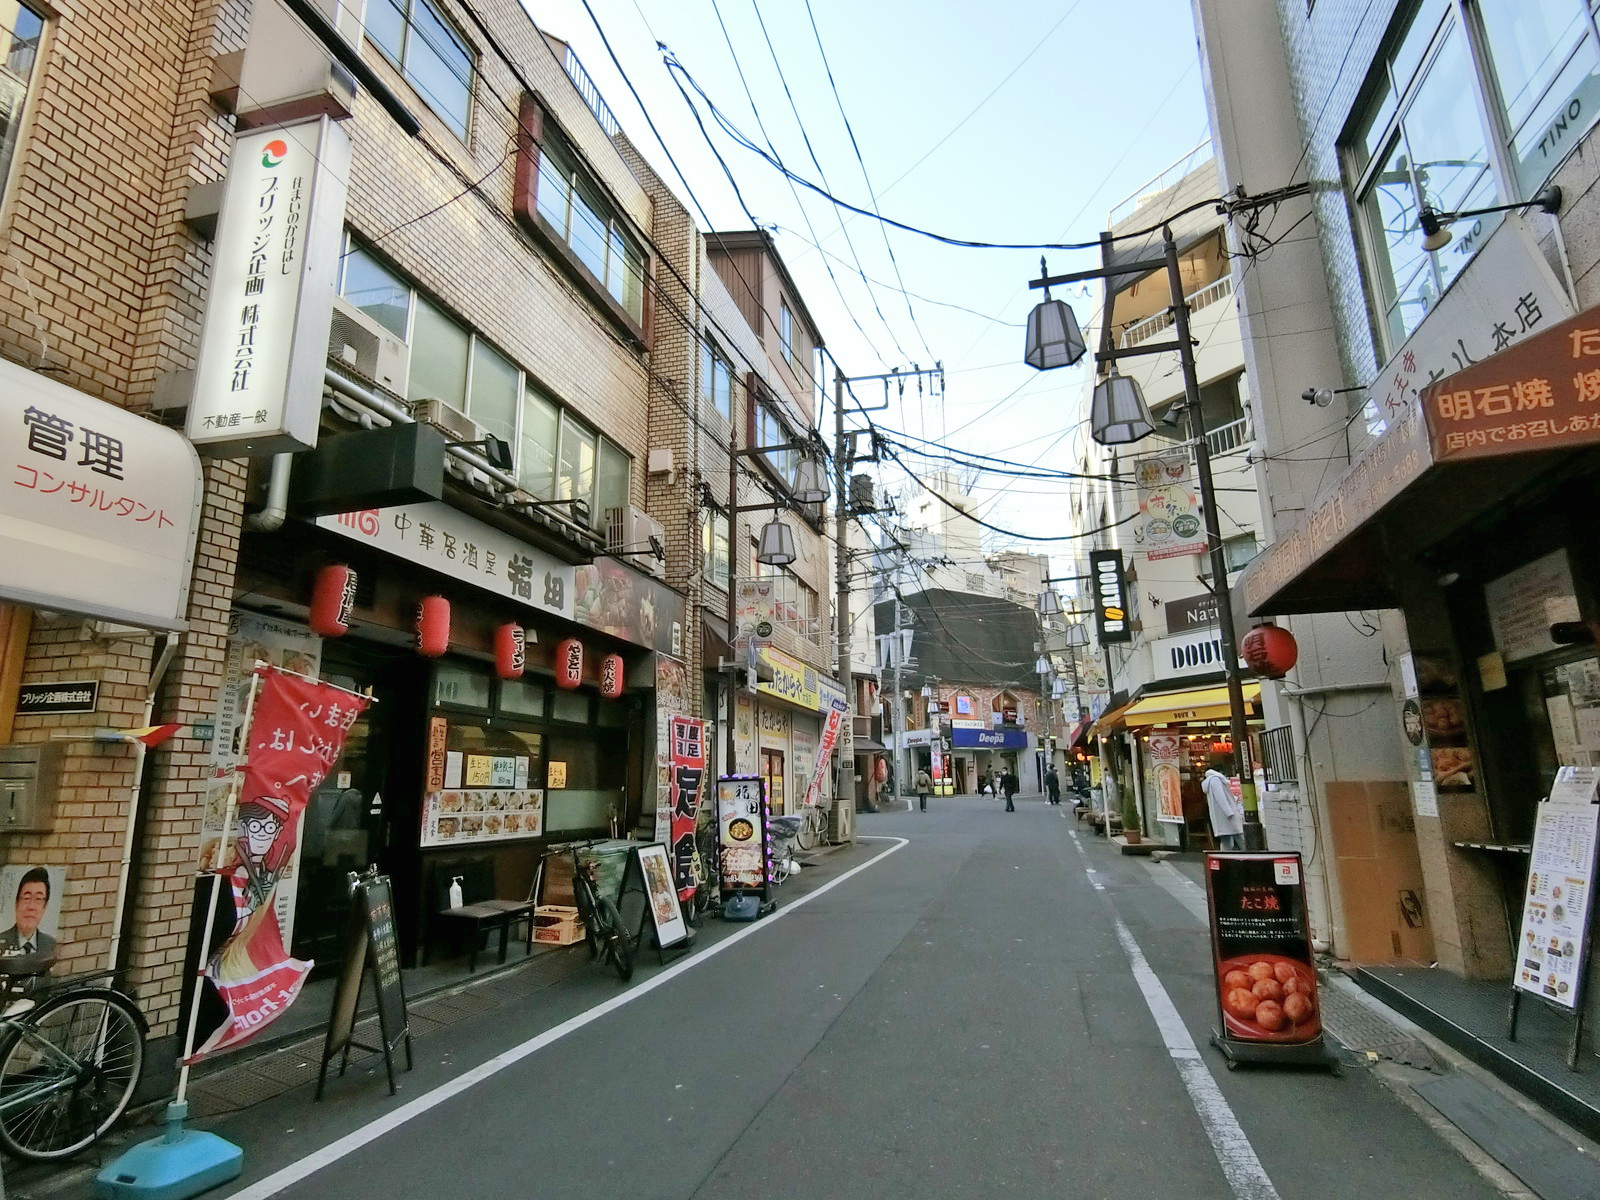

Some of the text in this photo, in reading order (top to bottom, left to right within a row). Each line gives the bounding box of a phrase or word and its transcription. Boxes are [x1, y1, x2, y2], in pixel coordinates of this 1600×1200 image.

[1538, 98, 1581, 158] TINO
[281, 177, 305, 276] 住まいのかけはし
[231, 175, 280, 392] ブリッジ企画 株式会社
[1385, 349, 1417, 418] 天王寺
[1438, 379, 1555, 421] 明石焼
[23, 405, 125, 481] 管理
[202, 409, 268, 429] 不動産一般
[14, 464, 175, 529] コンサルタント
[394, 512, 565, 611] 中華居酒屋 福田
[567, 643, 583, 681] やきとり
[603, 658, 616, 694] 炭火焼
[21, 690, 92, 705] ブリッジ企画株式会社
[979, 733, 1005, 744] Deepa
[675, 767, 703, 891] 定食
[1241, 895, 1280, 910] たこ焼
